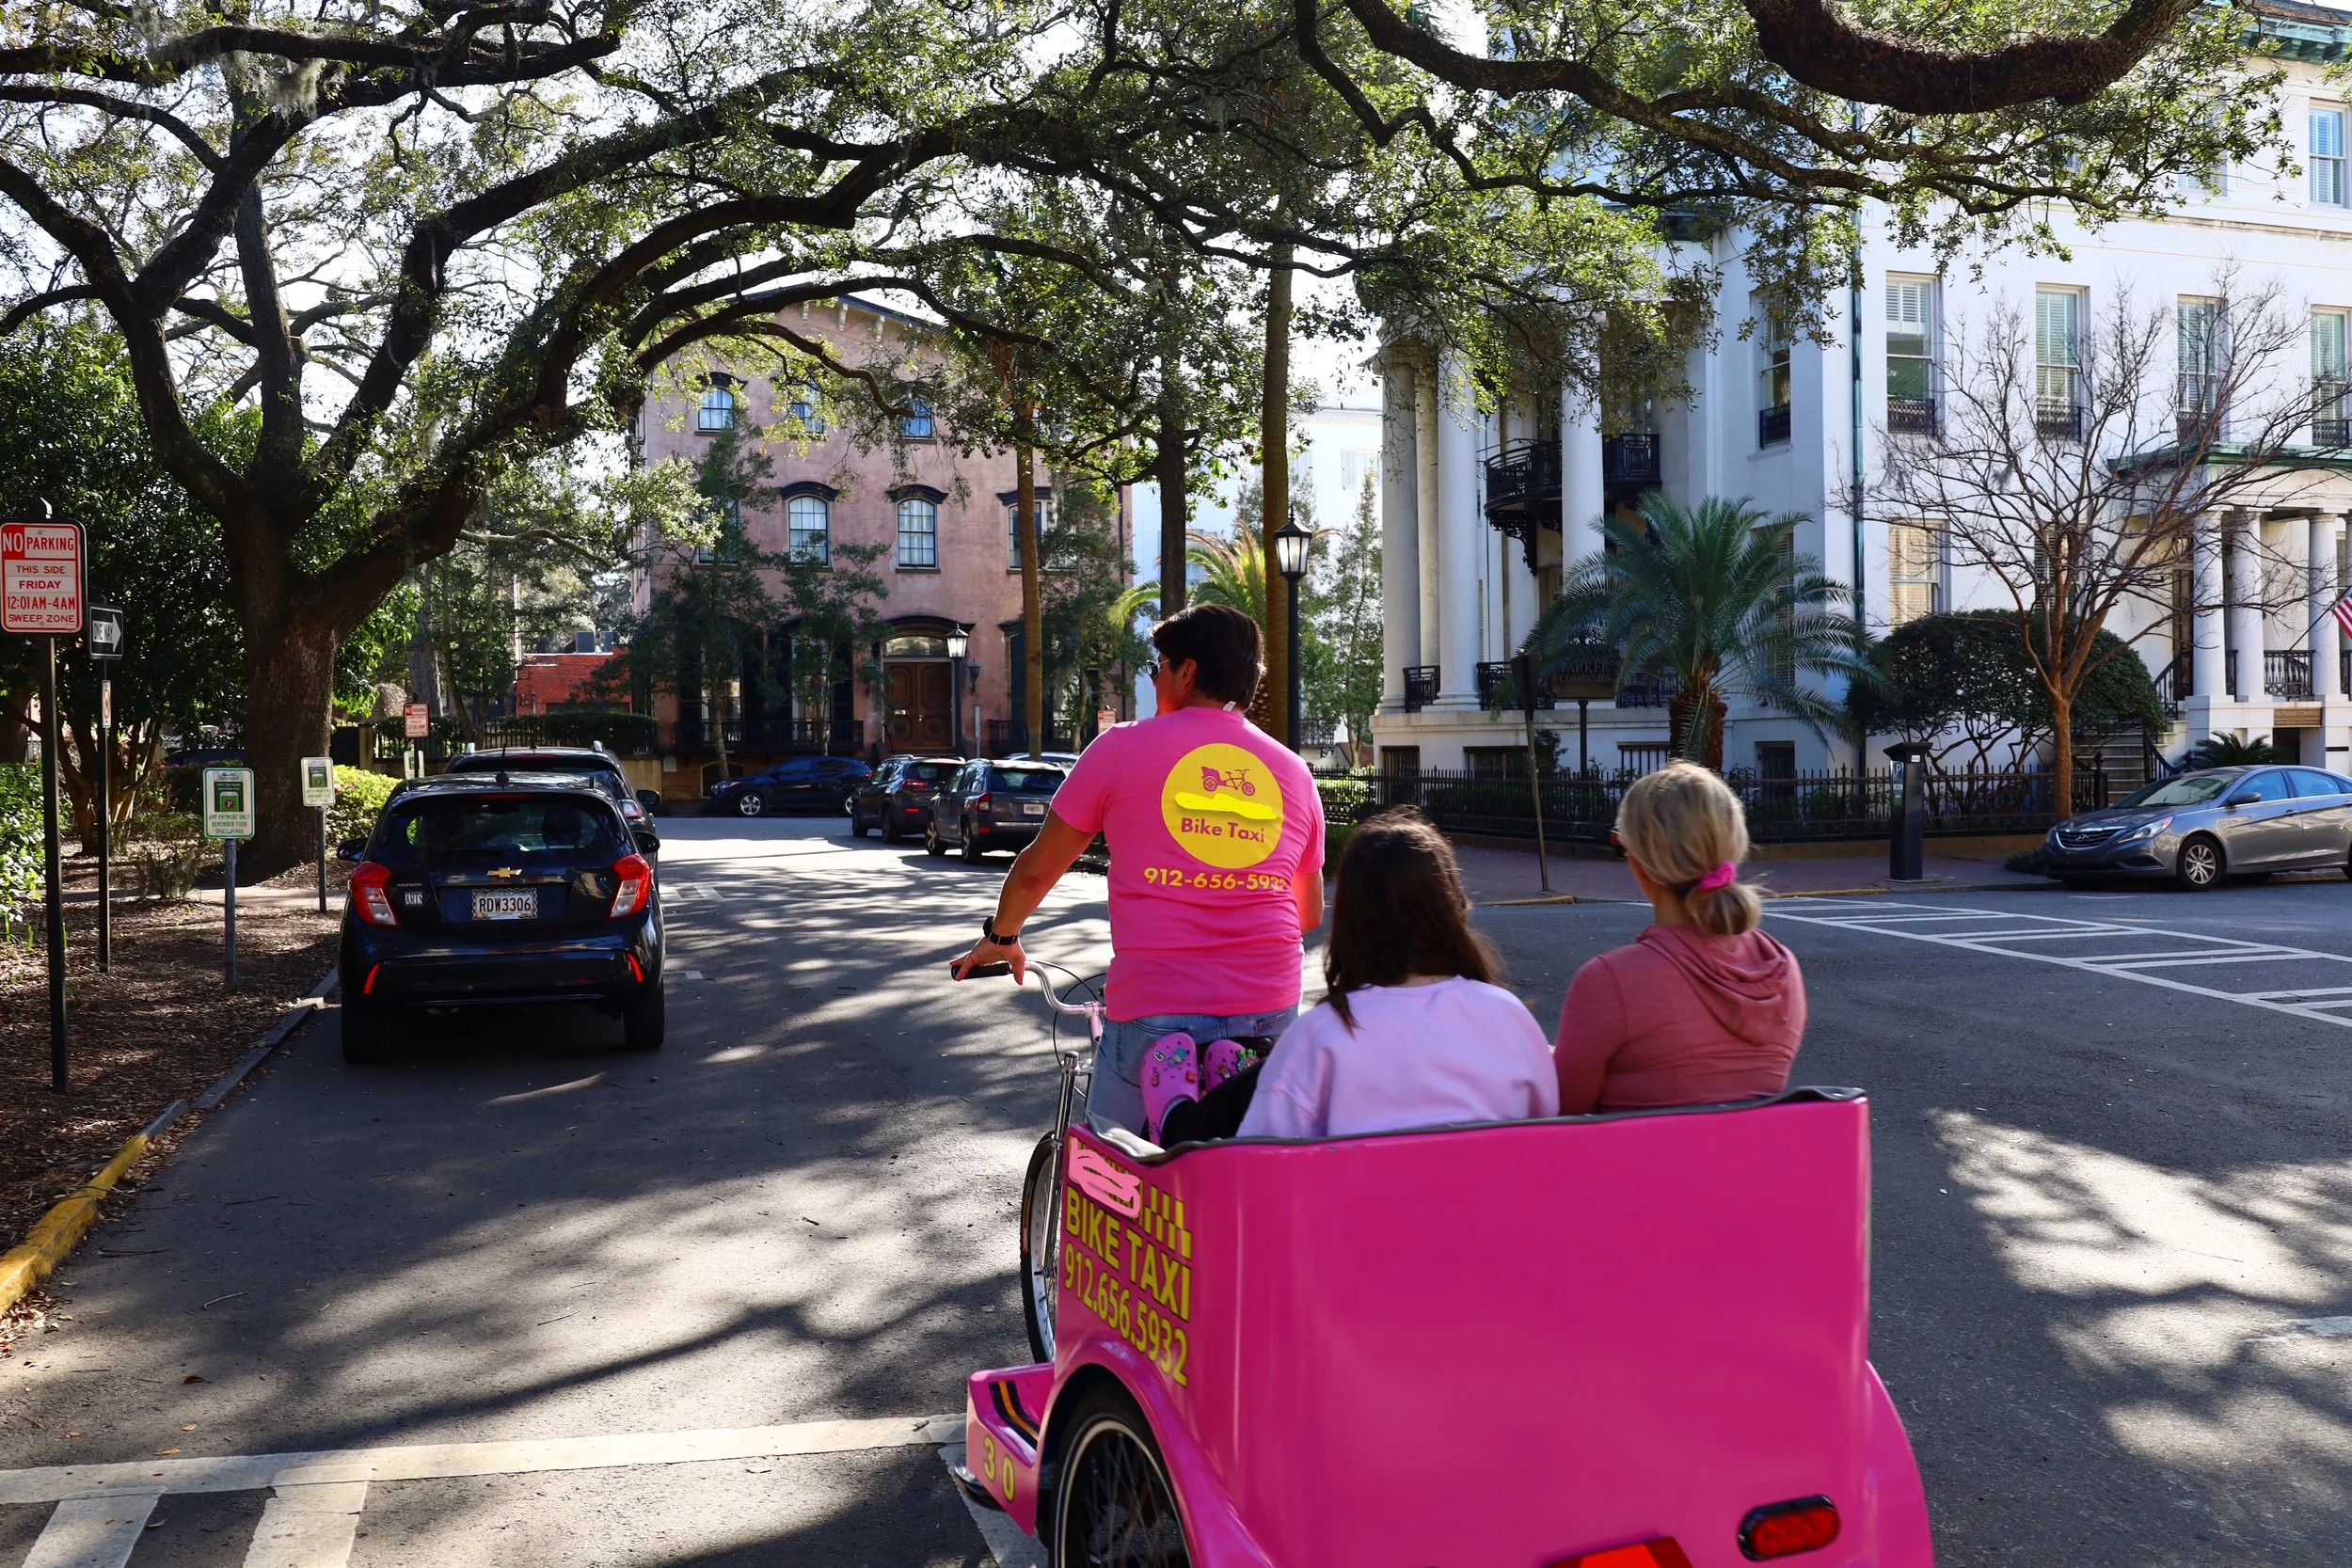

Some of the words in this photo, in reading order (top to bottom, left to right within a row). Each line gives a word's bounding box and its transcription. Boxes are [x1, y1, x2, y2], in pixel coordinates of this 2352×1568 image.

[2, 532, 24, 552] NO
[26, 537, 74, 551] PARKING
[16, 565, 39, 574] THIS
[43, 565, 66, 574] SIDE
[19, 580, 62, 590] FRIDAY
[8, 614, 43, 623] SWEEP
[1181, 817, 1223, 837] Bike
[1228, 821, 1264, 844] Taxi
[479, 897, 532, 912] RDW3306
[1066, 1184, 1120, 1271] BIKE
[1125, 1226, 1191, 1323] TAXI
[1064, 1241, 1189, 1388] 912.656.5932
